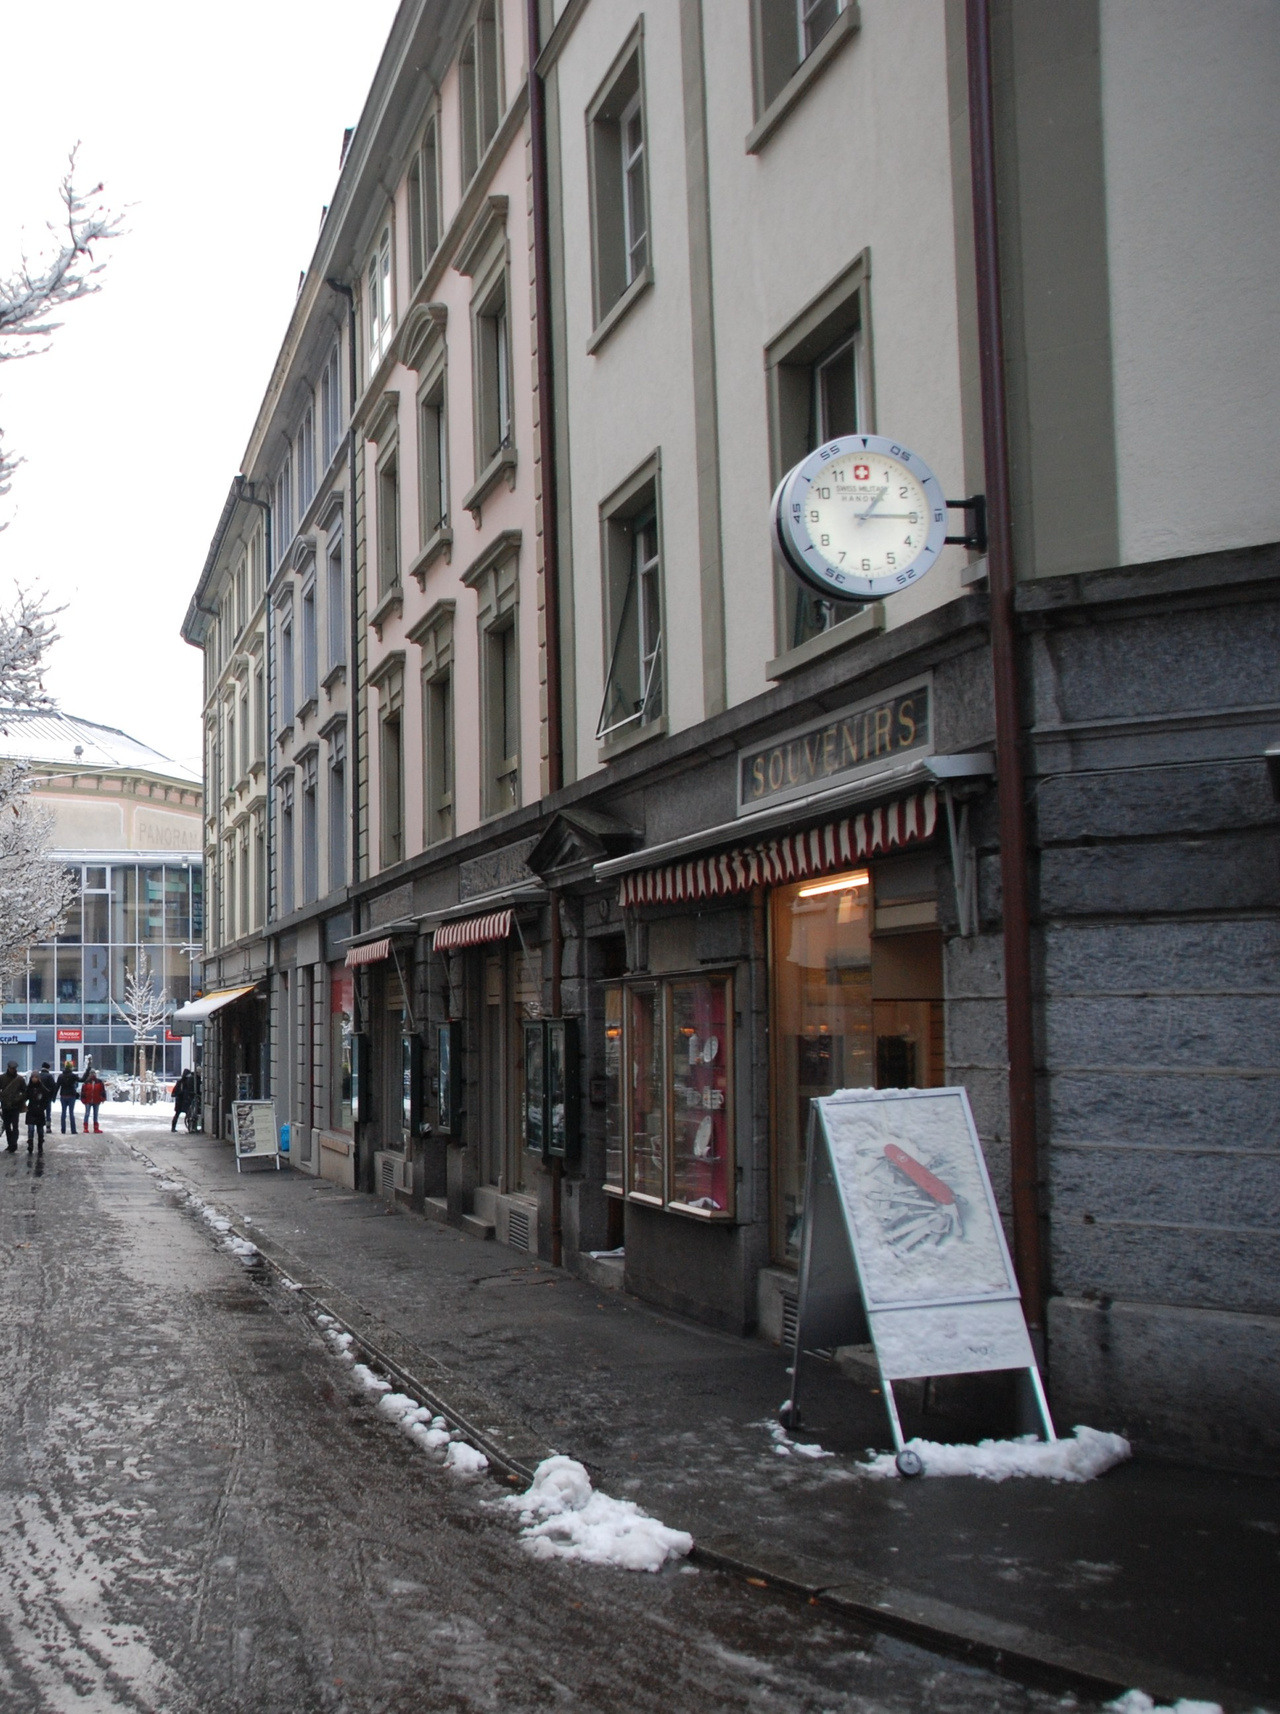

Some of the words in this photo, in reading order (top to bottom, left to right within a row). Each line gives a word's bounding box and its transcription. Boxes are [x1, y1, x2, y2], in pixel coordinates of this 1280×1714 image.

[820, 445, 840, 460] 55
[890, 445, 912, 461] 05
[832, 470, 845, 482] 11
[883, 471, 889, 482] 1
[816, 487, 830, 499] 10
[899, 487, 908, 499] 2
[793, 503, 801, 524] 45
[810, 510, 819, 523] 9
[934, 508, 943, 522] 15
[821, 534, 830, 546] 8
[904, 535, 912, 546] 4
[838, 552, 846, 564] 7
[887, 552, 896, 564] 5
[862, 559, 870, 571] 6
[753, 700, 916, 797] SOUVENIRS
[139, 823, 203, 850] PANORAM
